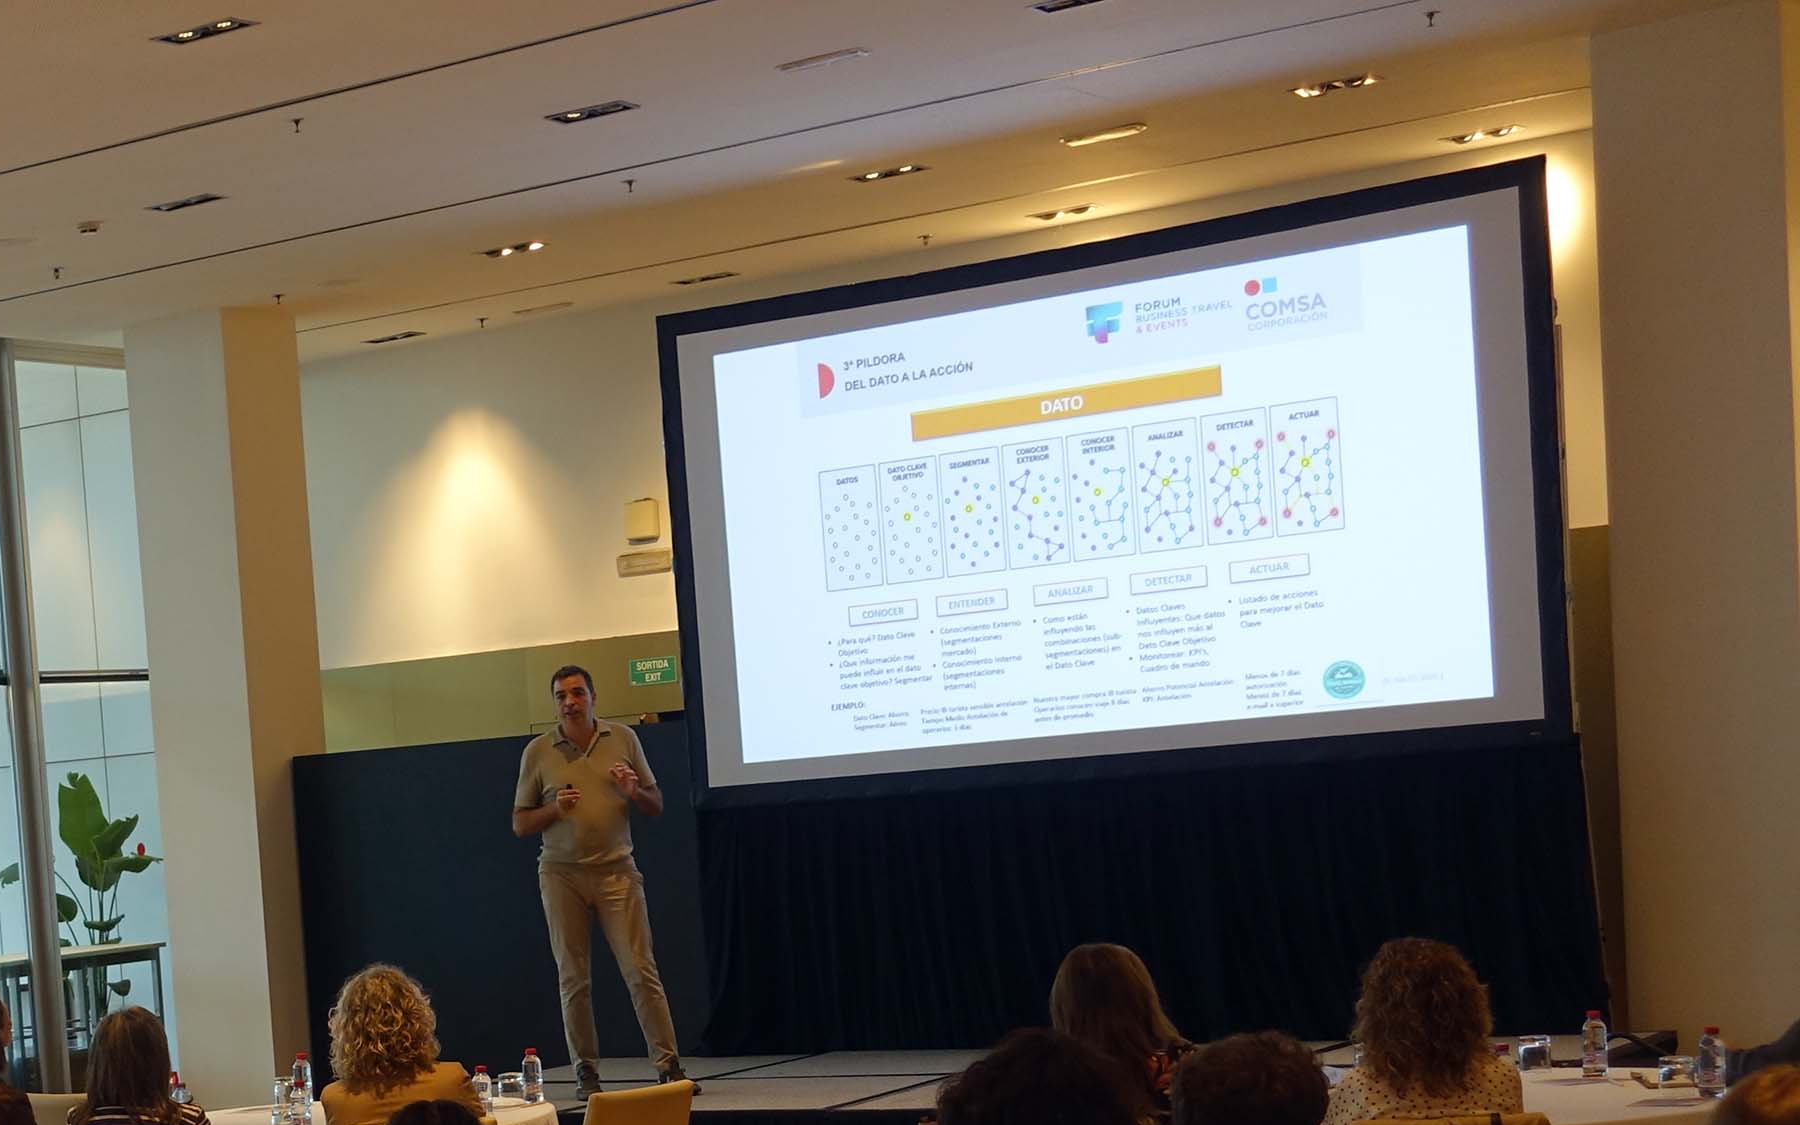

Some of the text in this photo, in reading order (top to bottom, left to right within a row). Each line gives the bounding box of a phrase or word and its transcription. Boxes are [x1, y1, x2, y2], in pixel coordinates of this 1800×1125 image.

[1135, 297, 1181, 313] FORUM
[1246, 292, 1327, 321] COMSA
[1136, 299, 1233, 324] BUSINESS TRAVEL
[1137, 318, 1188, 335] & EVENTS
[1247, 310, 1328, 332] CORPORACIÓN
[856, 352, 906, 369] PILDORA
[845, 359, 973, 392] DEL DATO A LA ACCIÓN
[1040, 395, 1084, 415] DATO
[1288, 410, 1319, 421] ACTUAR
[1216, 420, 1254, 432] DETECTAR
[1081, 435, 1115, 447] CONOCER
[1148, 430, 1184, 442] ANALIZAR
[1016, 445, 1049, 456] CONOCER
[1082, 444, 1115, 455] INTERIOR
[949, 458, 990, 469] SEGMENTAR
[1016, 453, 1050, 464] EXTERIOR
[888, 463, 927, 475] DATO CLAVE
[836, 477, 858, 486] DATOS
[893, 471, 924, 482] OBJETIVO
[1250, 562, 1289, 575] ACTUAR
[1145, 573, 1192, 587] DETECTAR
[1048, 585, 1094, 598] ANALIZAR
[1239, 590, 1318, 604] Listado de acciones
[948, 596, 995, 610] ENTENDER
[1136, 602, 1186, 615] Datos Claves
[1240, 609, 1258, 618] para
[1260, 605, 1292, 615] mejorar
[1304, 600, 1324, 609] Dato
[862, 607, 904, 619] CONOCER
[1043, 615, 1065, 624] Como
[1240, 620, 1262, 628] Clave
[940, 623, 991, 635] Conocimiento
[877, 633, 894, 641] Dato
[896, 630, 916, 639] Clave
[1139, 635, 1216, 650] Dato Clave Objetivo
[839, 647, 869, 657] Objetivo
[636, 659, 669, 671] SORTIDA
[942, 657, 993, 669] Conocimiento
[1055, 661, 1073, 670] Dato
[1074, 659, 1095, 668] Clave
[1140, 660, 1210, 673] Cuadro de mando
[645, 672, 661, 681] EXIT
[840, 671, 862, 680] puede
[905, 664, 922, 672] dato
